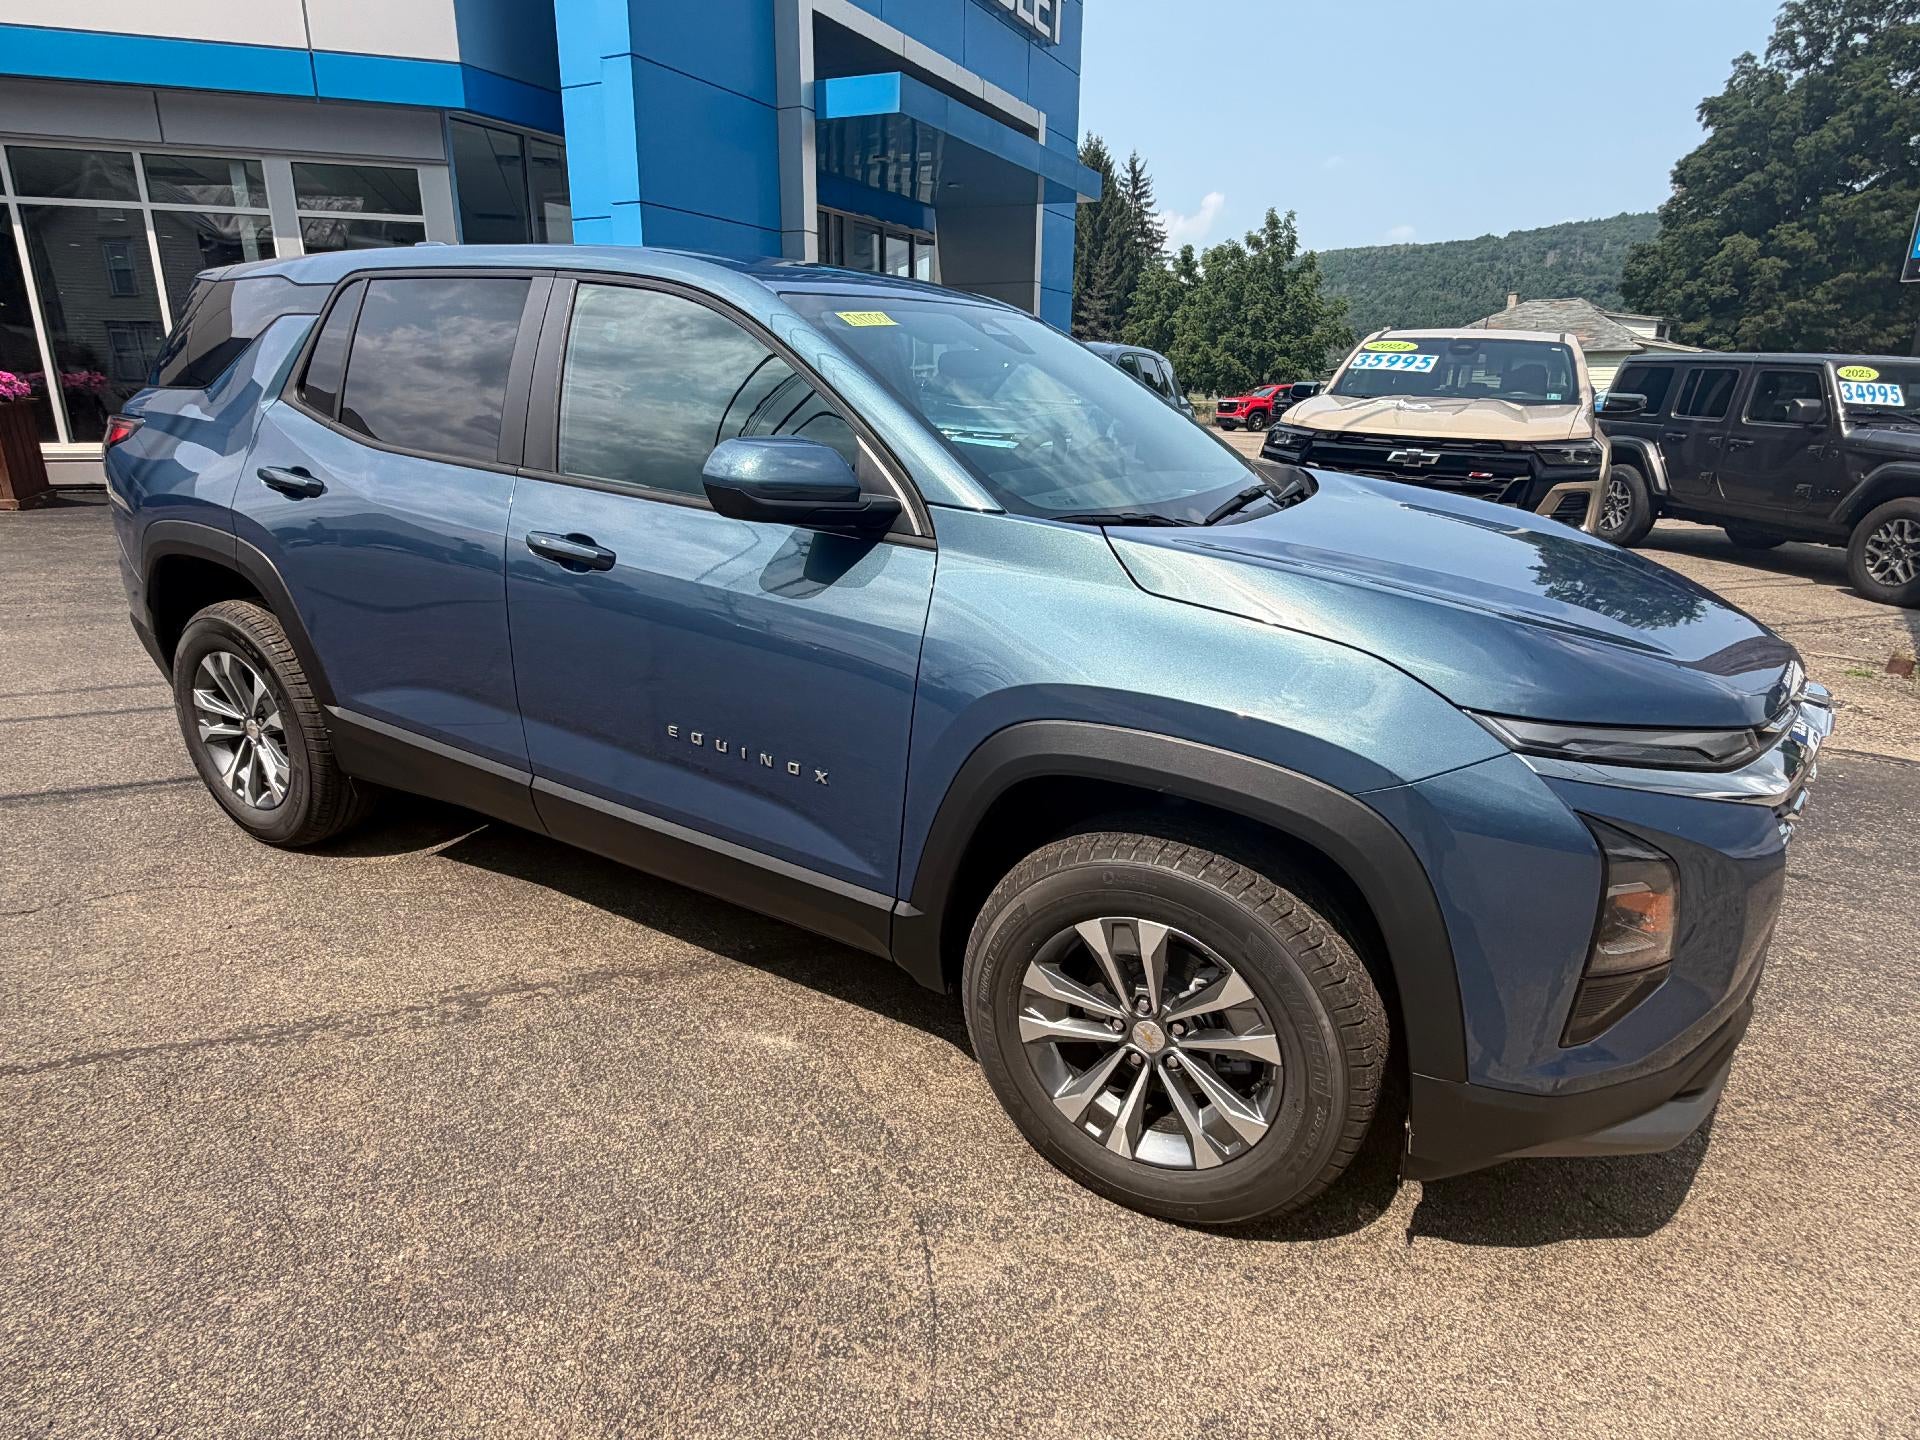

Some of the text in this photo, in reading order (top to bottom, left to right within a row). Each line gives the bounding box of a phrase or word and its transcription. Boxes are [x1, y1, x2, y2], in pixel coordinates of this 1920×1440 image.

[1352, 354, 1435, 370] 35995
[1845, 369, 1872, 378] 2025
[1841, 383, 1900, 403] 34995
[667, 725, 829, 785] EQUINOX
